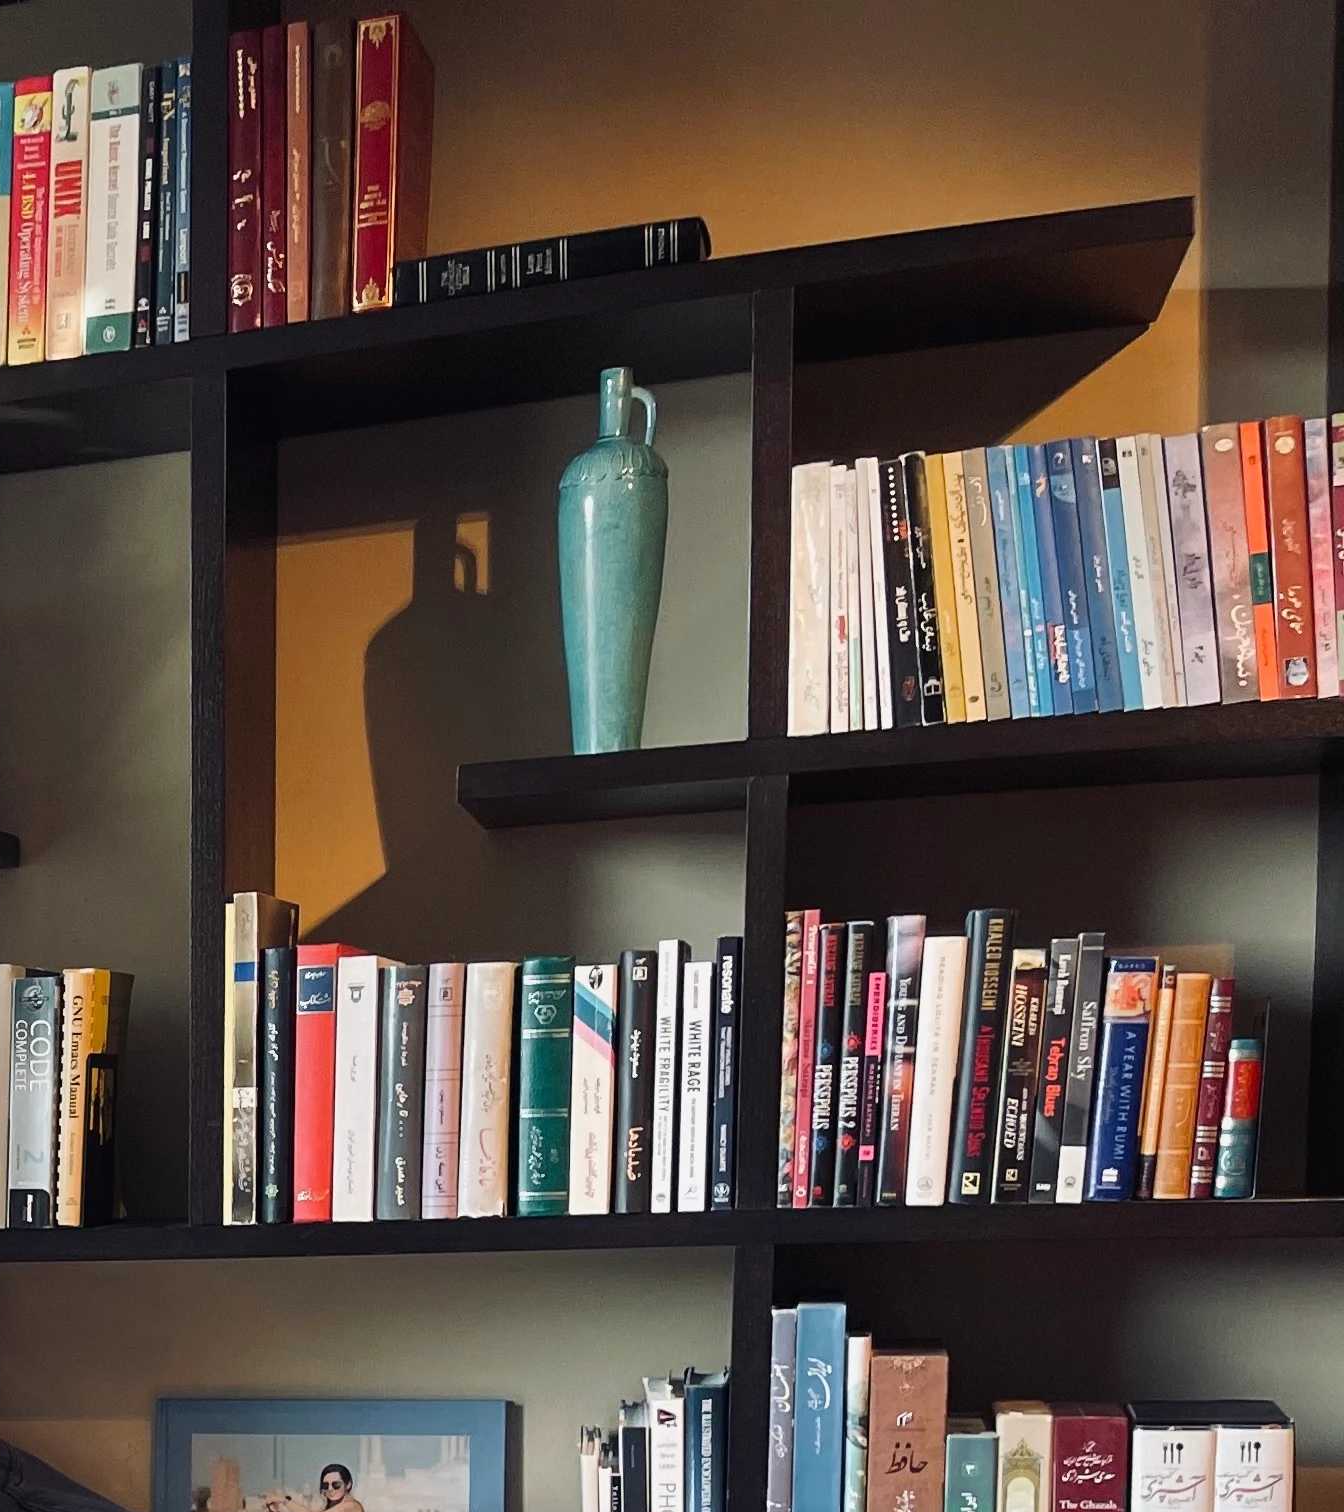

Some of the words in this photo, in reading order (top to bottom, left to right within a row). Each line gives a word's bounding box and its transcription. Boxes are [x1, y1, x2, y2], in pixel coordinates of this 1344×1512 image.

[54, 160, 82, 218] UNIX
[17, 222, 34, 279] Operating
[986, 918, 1005, 960] KHALED
[720, 956, 734, 1013] resonate
[981, 963, 1001, 1011] HOSSEINI
[71, 995, 83, 1026] GNU
[896, 1013, 907, 1034] AND
[1011, 984, 1028, 1047] HOSSEINI
[1078, 1001, 1097, 1051] Saffron
[15, 1020, 27, 1091] COMPLETE
[29, 1020, 51, 1091] CODE
[70, 1032, 82, 1070] Emacs
[659, 1016, 671, 1053] WHITE
[688, 1020, 702, 1057] WHITE
[1126, 1032, 1136, 1040] A
[687, 1062, 701, 1093] RAGE
[1045, 1038, 1066, 1080] Tehran
[1071, 1057, 1092, 1081] Sky
[1121, 1046, 1135, 1080] YEAR
[68, 1075, 80, 1118] Manual
[657, 1058, 671, 1111] FRAGILITY
[812, 1065, 833, 1130] PERSEPOLIS
[840, 1057, 859, 1118] PERSEPOLIS
[1044, 1085, 1060, 1117] Blues
[1118, 1085, 1133, 1121] WITH
[1003, 1098, 1019, 1148] ECHOED
[1113, 1126, 1127, 1160] RUMI
[1059, 1500, 1078, 1509] The
